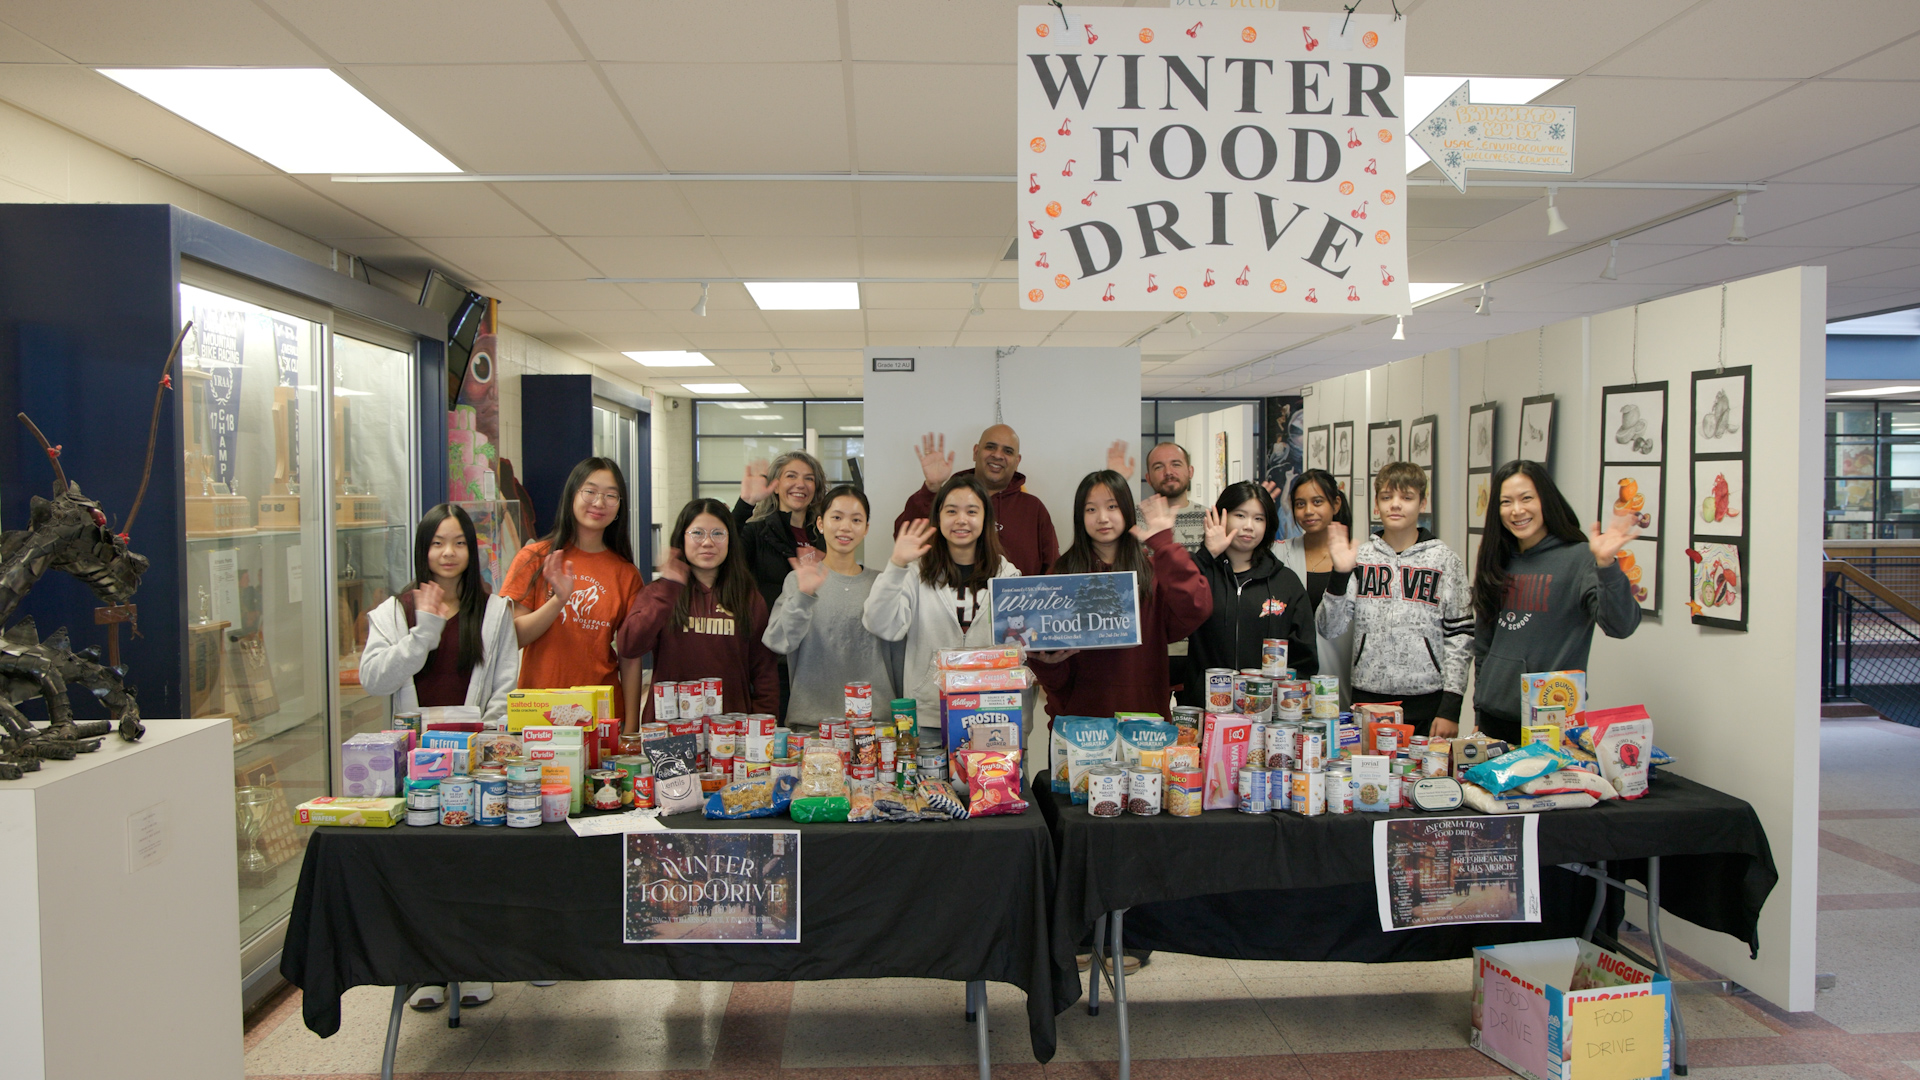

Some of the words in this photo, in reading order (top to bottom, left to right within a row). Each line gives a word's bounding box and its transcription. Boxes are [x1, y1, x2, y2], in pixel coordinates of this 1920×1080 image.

[1026, 53, 1399, 118] WINTER
[1456, 105, 1529, 124] BROUGHT
[1530, 107, 1556, 124] TO
[1483, 122, 1513, 137] YOU
[1517, 123, 1541, 139] BY
[1093, 124, 1341, 183] FOOD
[1519, 154, 1562, 165] COUNCIL
[1061, 191, 1363, 280] DRIVE
[202, 331, 237, 351] MOUNTAIN
[201, 344, 217, 360] BIKE
[218, 347, 240, 364] RACING
[210, 412, 218, 429] 17
[226, 414, 234, 431] 18
[580, 574, 607, 595] SCHOOL
[999, 591, 1076, 612] Winter
[573, 617, 611, 628] WOLFPACK
[682, 616, 735, 636] PUMA
[1040, 612, 1082, 633] Food
[1087, 611, 1131, 632] Drive
[1508, 613, 1532, 630] SCHOOL
[951, 698, 977, 707] Kellogg's
[1555, 681, 1574, 707] BUNCHES
[961, 712, 1009, 729] FROSTED
[525, 731, 551, 739] Christie
[1076, 730, 1109, 742] LIVIVA
[1132, 731, 1167, 741] LIVIVA
[1230, 745, 1238, 784] WAFERS
[1424, 820, 1485, 835] INFORMATION
[1434, 829, 1454, 839] FOOD
[1455, 829, 1476, 837] DRIVE
[659, 854, 755, 882] WINTER
[1453, 856, 1471, 864] FREE
[1471, 855, 1517, 863] BREAKFAST
[1484, 863, 1513, 872] MERCH
[641, 879, 704, 902] FOOD
[704, 878, 783, 902] DRIVE
[689, 905, 701, 914] DEC
[1597, 952, 1651, 984] HUGGIES
[1495, 982, 1529, 1010] FOOD
[1490, 1007, 1532, 1044] DRIVE
[1594, 1009, 1633, 1026] FOOD
[1587, 1037, 1635, 1058] DRIVE
